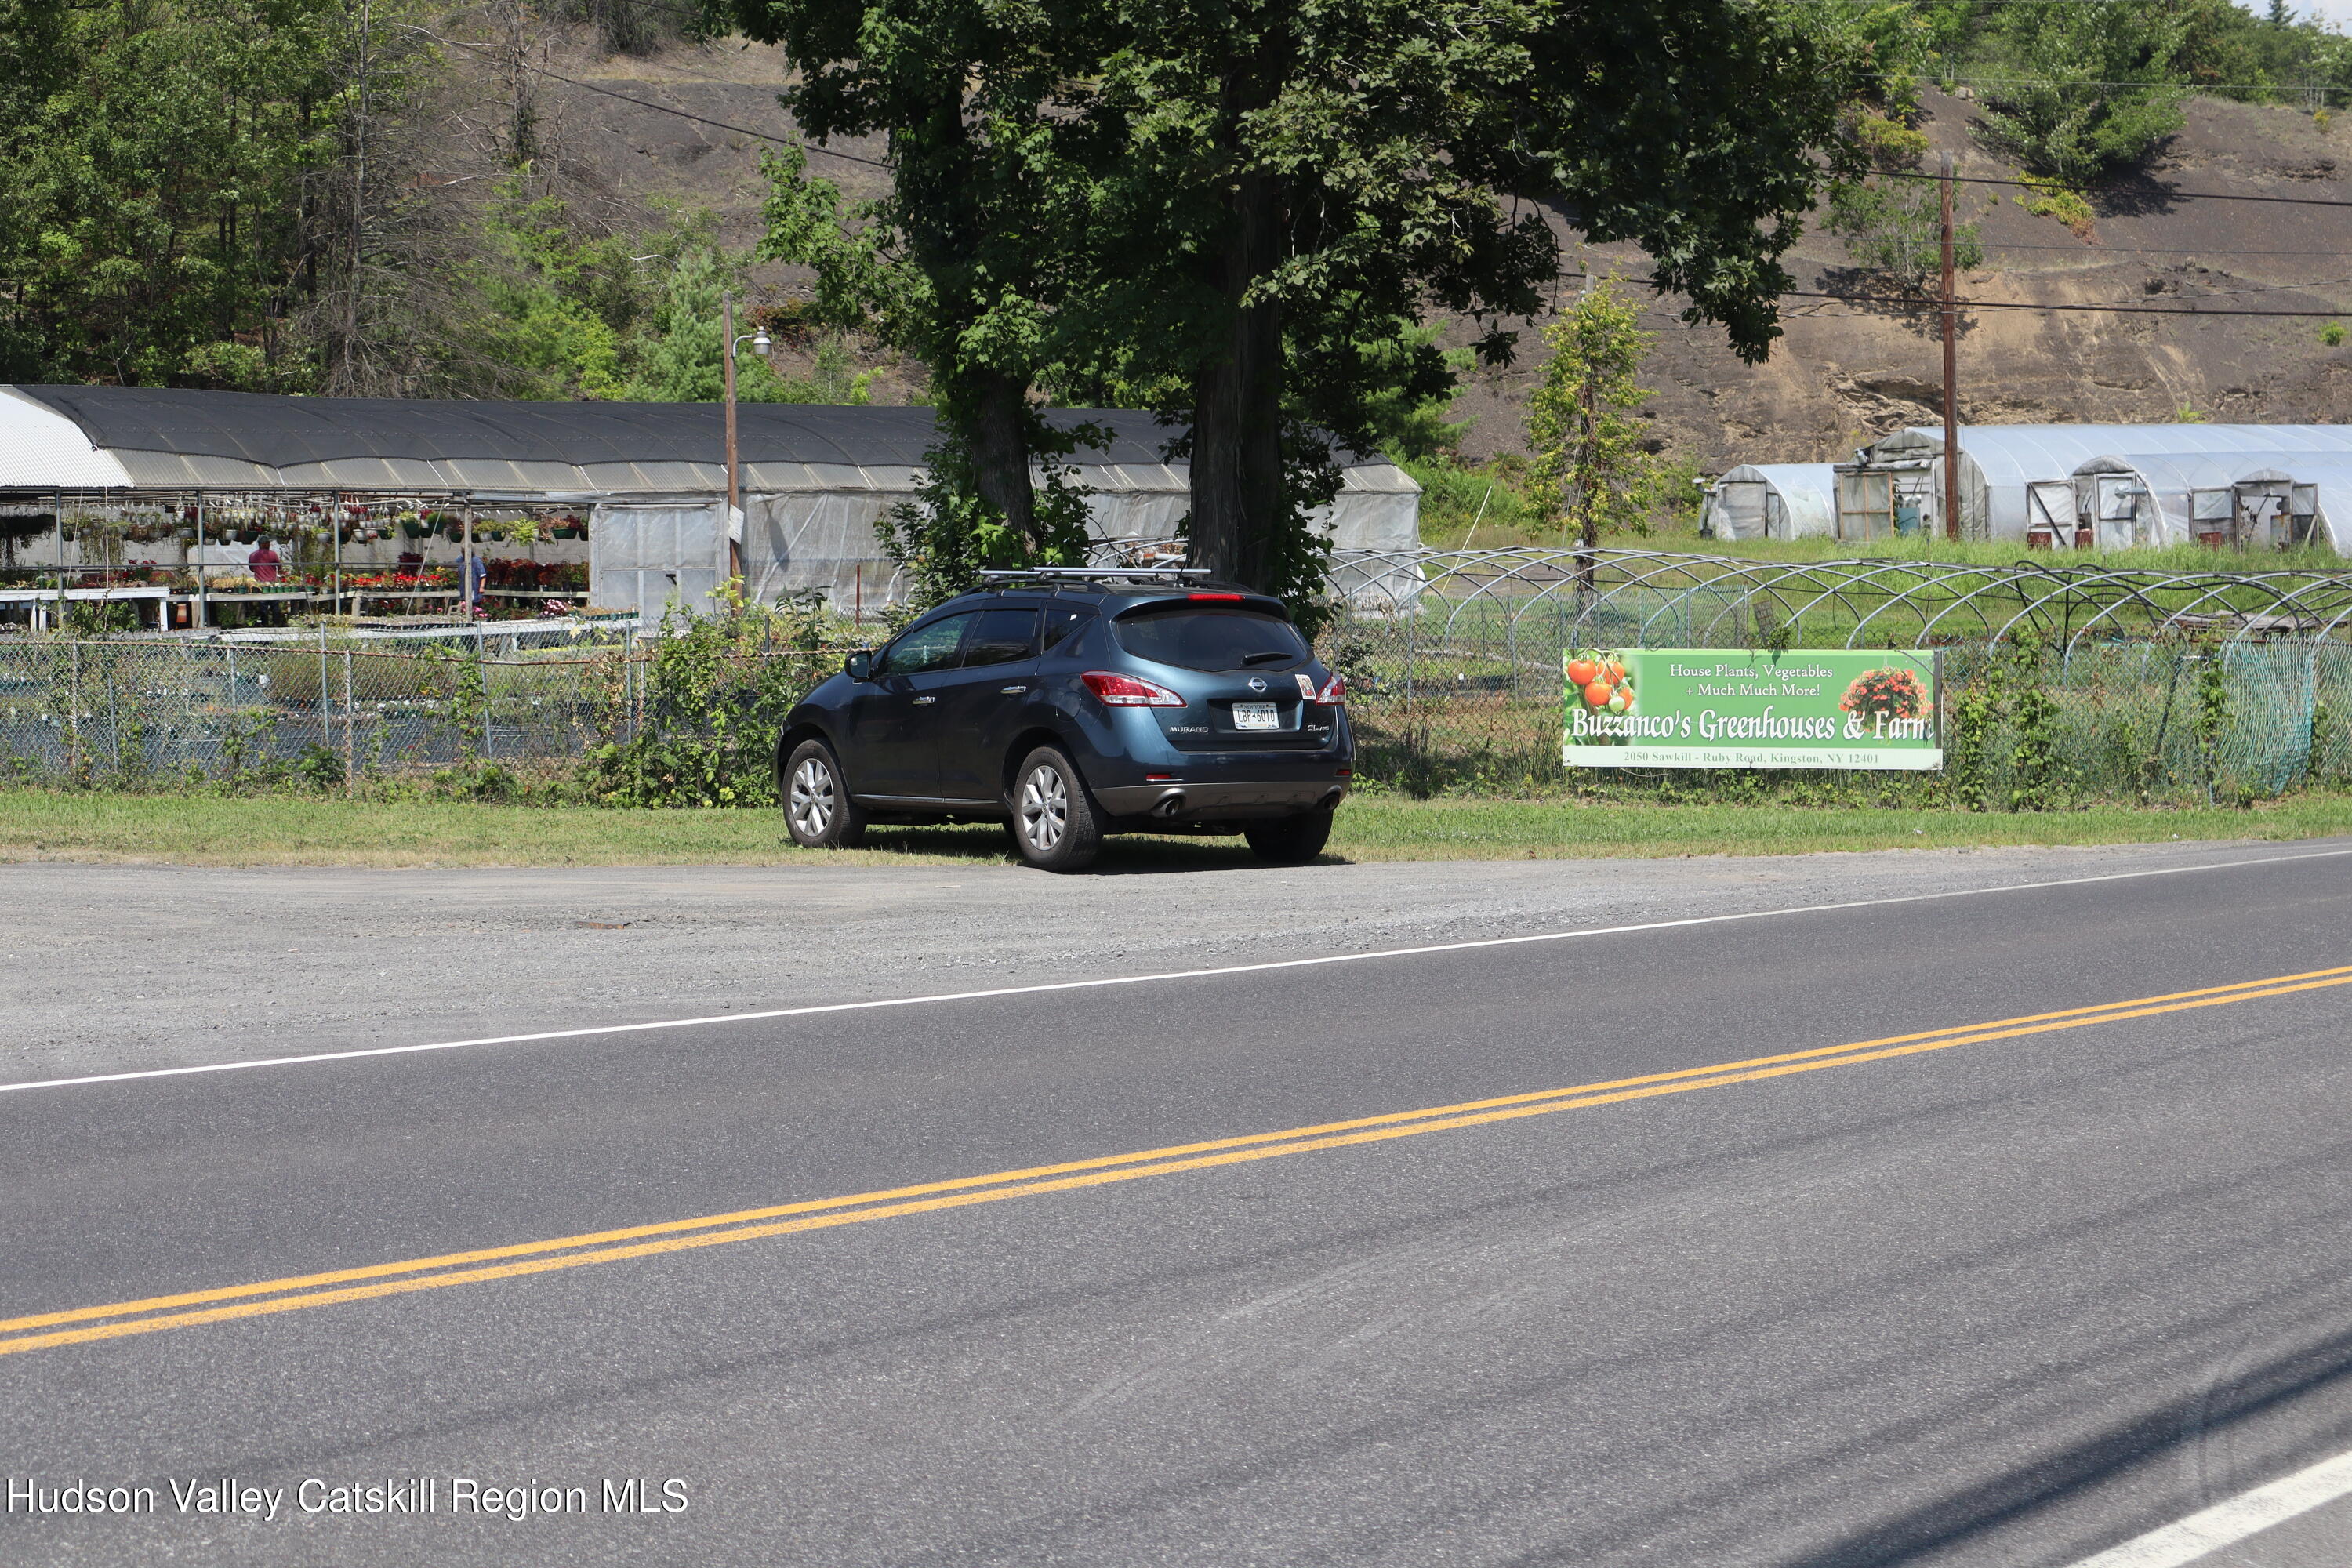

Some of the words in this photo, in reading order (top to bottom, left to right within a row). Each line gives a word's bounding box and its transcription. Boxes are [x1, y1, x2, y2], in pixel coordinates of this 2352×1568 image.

[1669, 663, 1711, 677] House
[1715, 663, 1759, 680] Plants,
[1762, 663, 1833, 680] Vegetables
[1697, 683, 1736, 696] Much
[1739, 683, 1777, 696] Much
[1781, 683, 1820, 696] More!
[1571, 707, 1691, 739] Buzzanco's
[1698, 705, 1835, 742] Greenhouses
[1842, 710, 1866, 739] &
[1873, 710, 1934, 740] Farm
[1624, 751, 1648, 761] 2050
[1652, 752, 1692, 762] Sawkill
[1703, 752, 1730, 764] Ruby
[1735, 752, 1767, 764] Road,
[1771, 753, 1823, 765] Kingston,
[1827, 753, 1844, 764] NY
[1848, 753, 1878, 764] 12401
